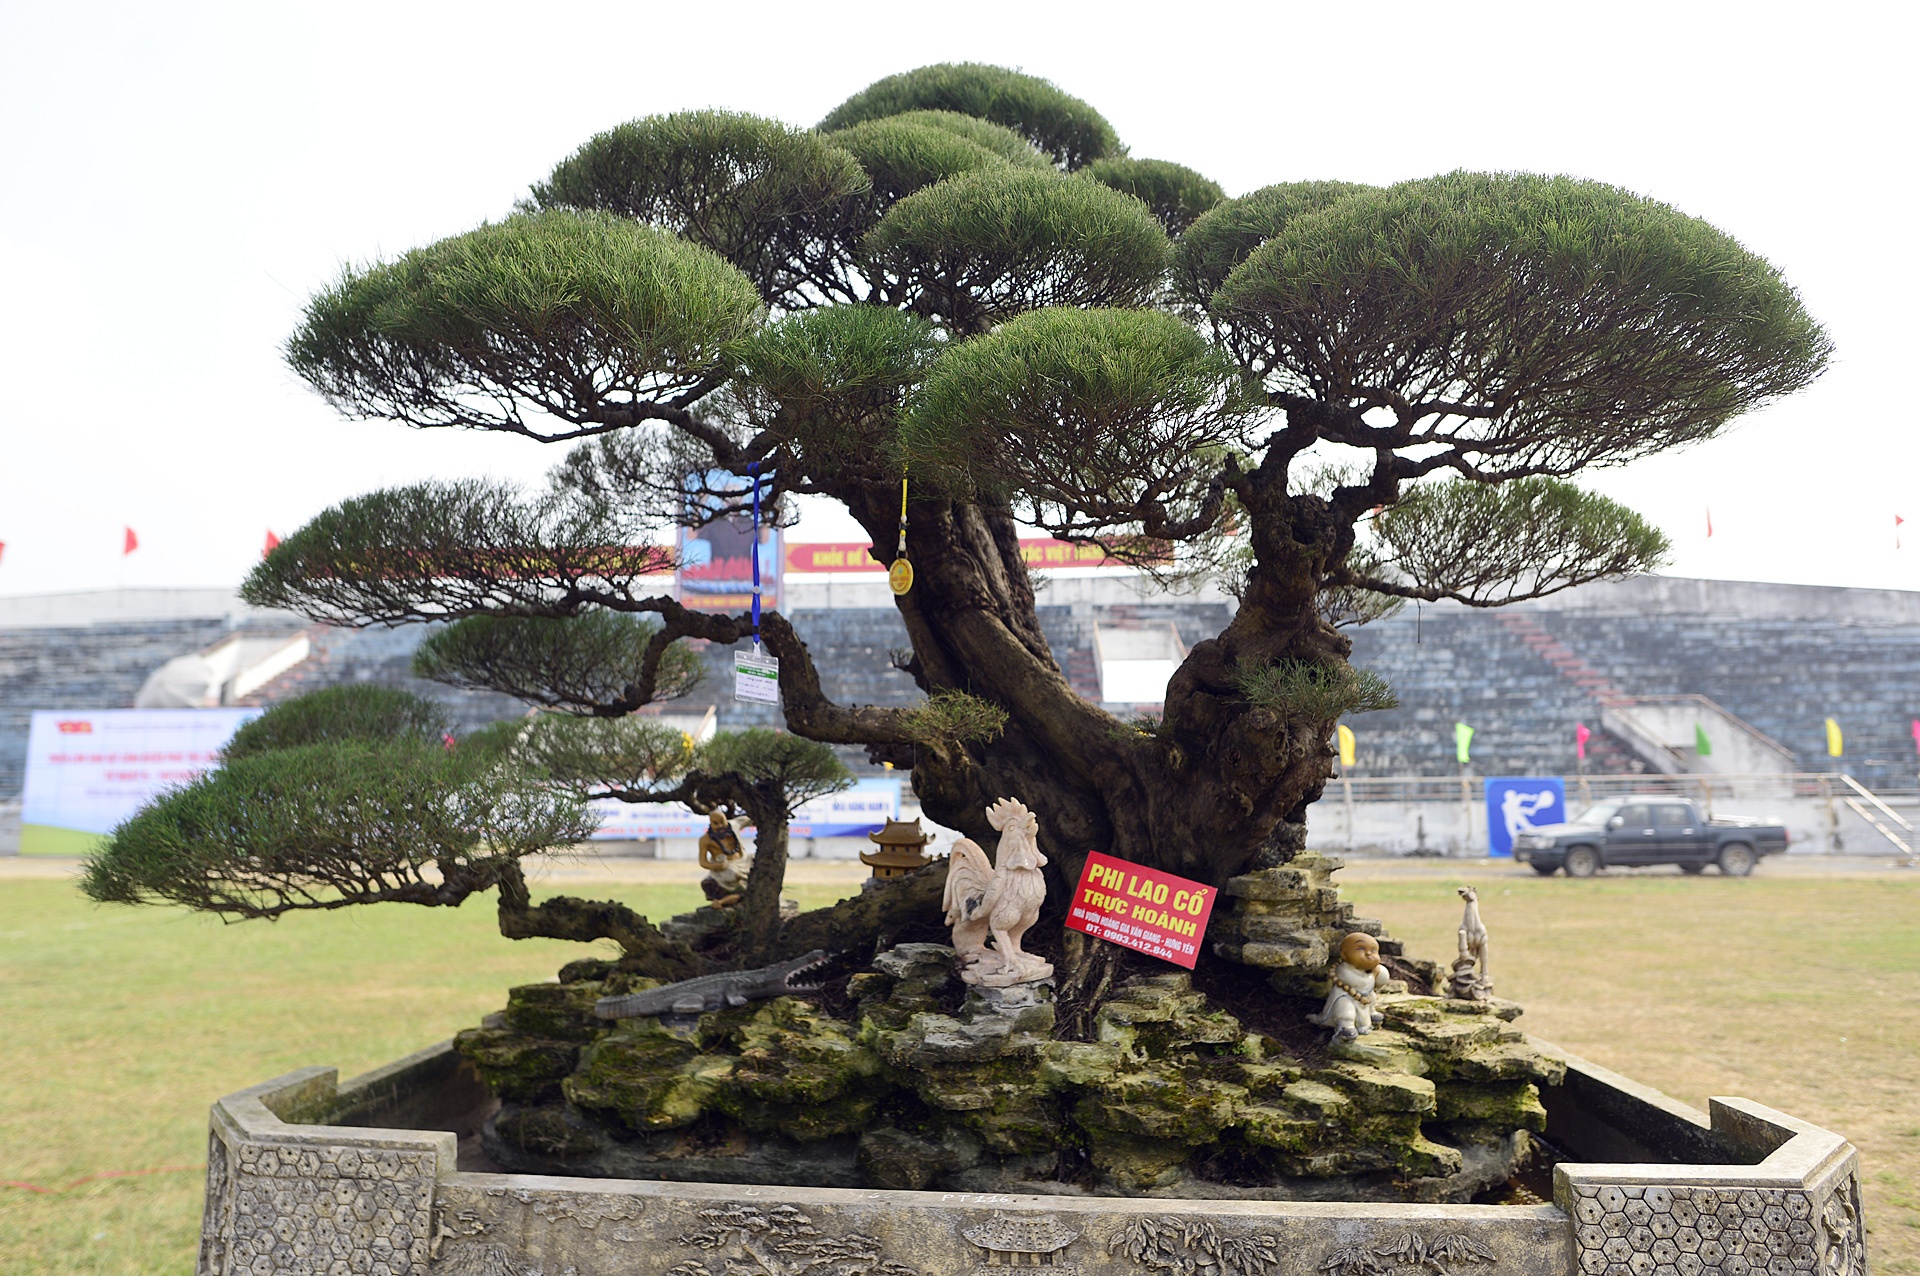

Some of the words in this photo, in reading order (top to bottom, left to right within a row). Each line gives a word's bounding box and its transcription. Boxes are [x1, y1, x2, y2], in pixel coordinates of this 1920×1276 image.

[1083, 888, 1129, 915] TRỰC
[1131, 905, 1198, 937] HOÀNH
[1087, 863, 1125, 892] PHI
[1127, 875, 1169, 905] LAO
[1173, 888, 1209, 916] CỔ
[1072, 907, 1086, 919] NHÀ
[1119, 922, 1131, 934] GIA
[1142, 930, 1161, 944] GIANG
[1182, 942, 1195, 955] YÊN
[1103, 929, 1173, 959] 0903.412.844
